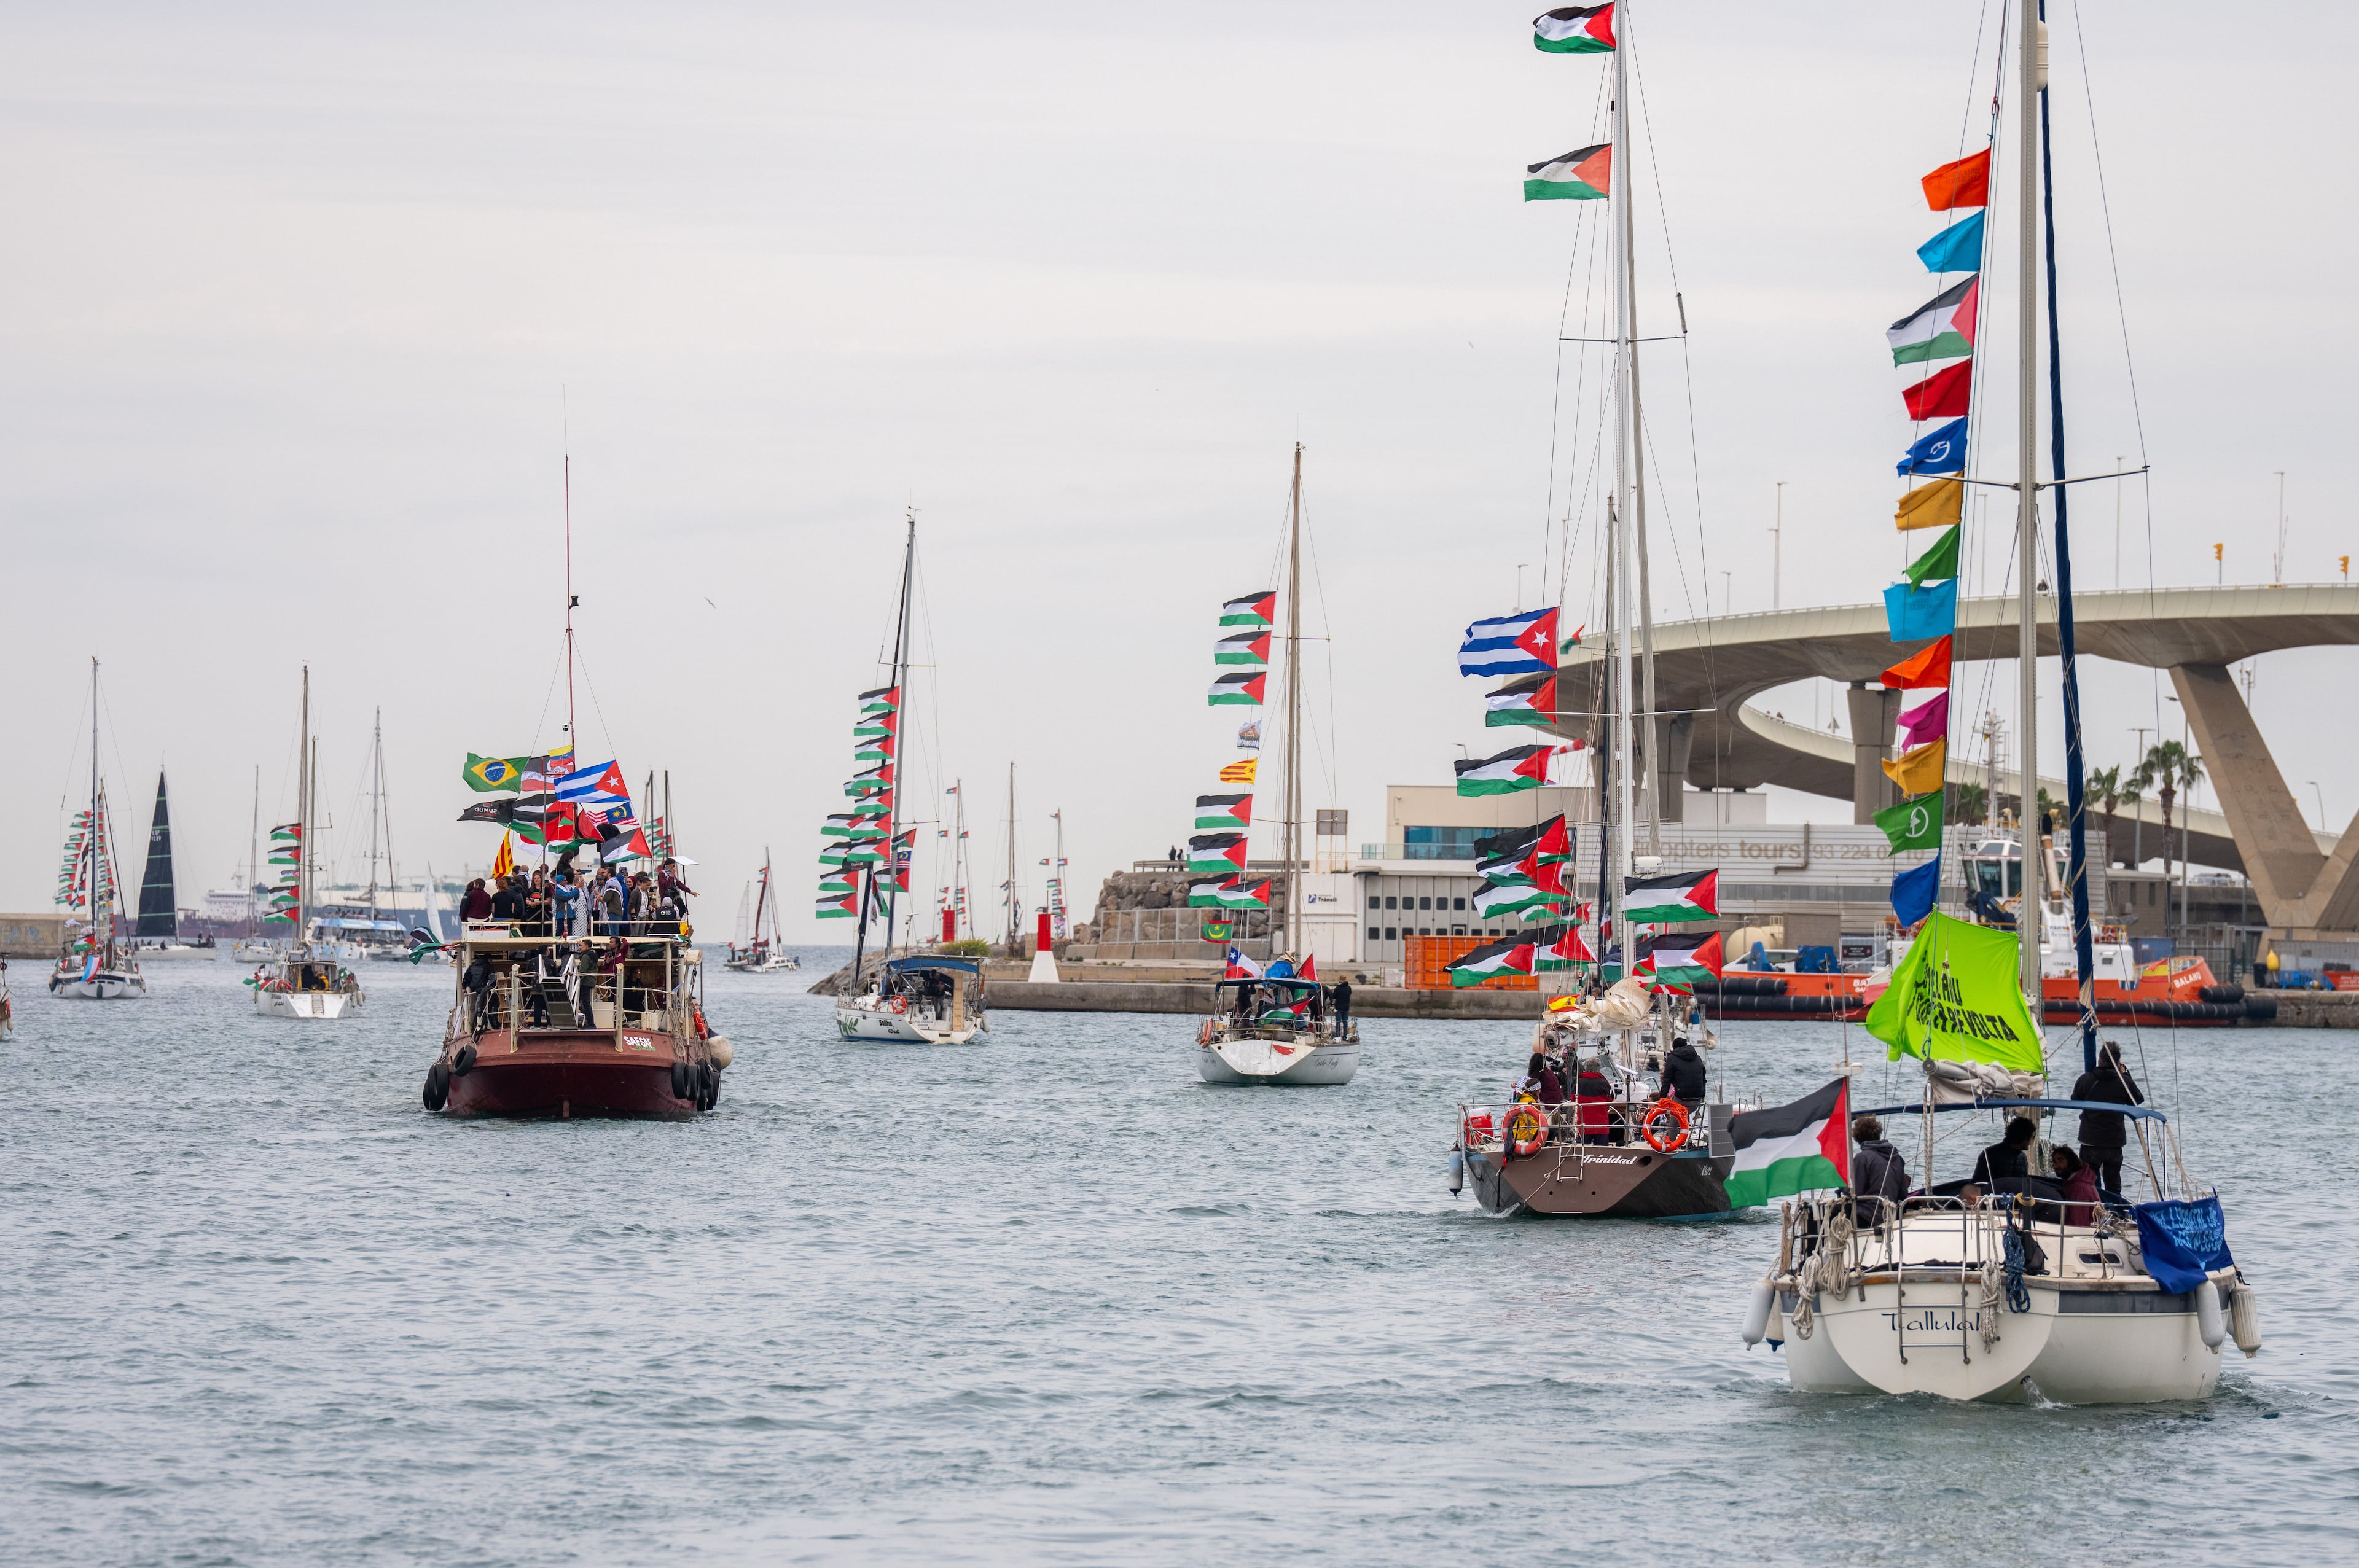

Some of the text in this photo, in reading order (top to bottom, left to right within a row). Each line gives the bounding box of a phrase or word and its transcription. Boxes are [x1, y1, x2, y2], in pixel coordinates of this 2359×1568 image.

[1739, 839, 1801, 858] tours
[1813, 844, 1834, 859] 93
[1841, 844, 1871, 859] 224
[624, 1036, 652, 1048] SAFSAF
[1583, 1155, 1637, 1164] Trinidad
